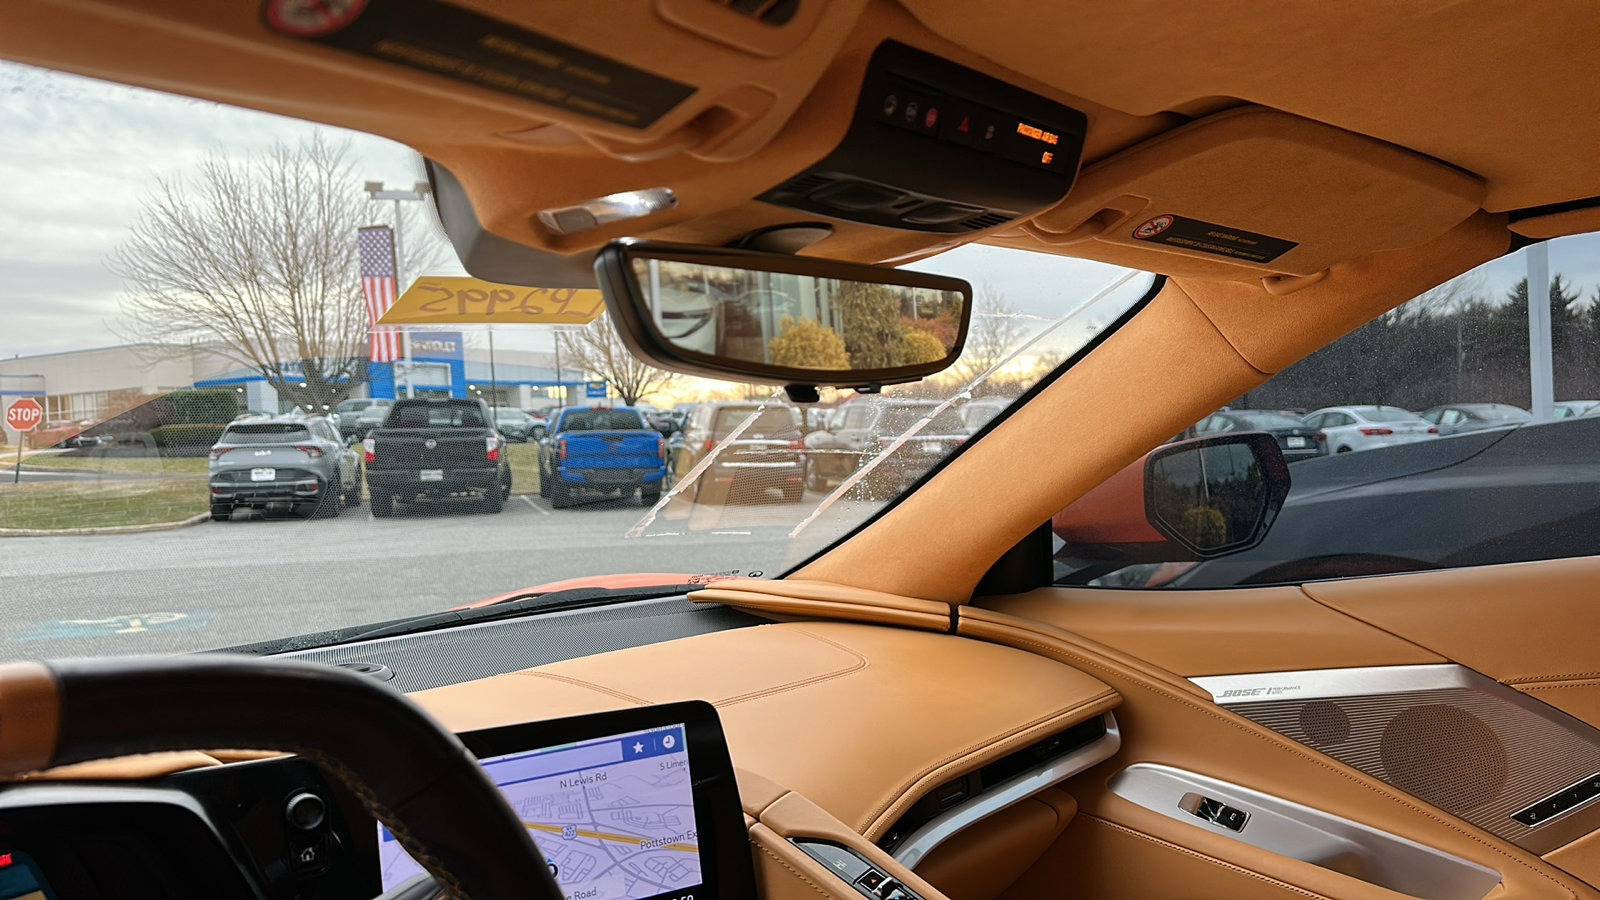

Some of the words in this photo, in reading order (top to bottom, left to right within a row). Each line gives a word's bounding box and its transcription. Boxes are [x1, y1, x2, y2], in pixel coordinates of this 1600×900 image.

[8, 407, 40, 421] STOP
[1216, 687, 1266, 698] BOSE
[659, 762, 666, 771] S
[559, 779, 567, 789] N
[569, 775, 594, 787] Lewis
[595, 771, 607, 782] Rd
[640, 833, 686, 850] Pottstown
[574, 885, 597, 900] Road
